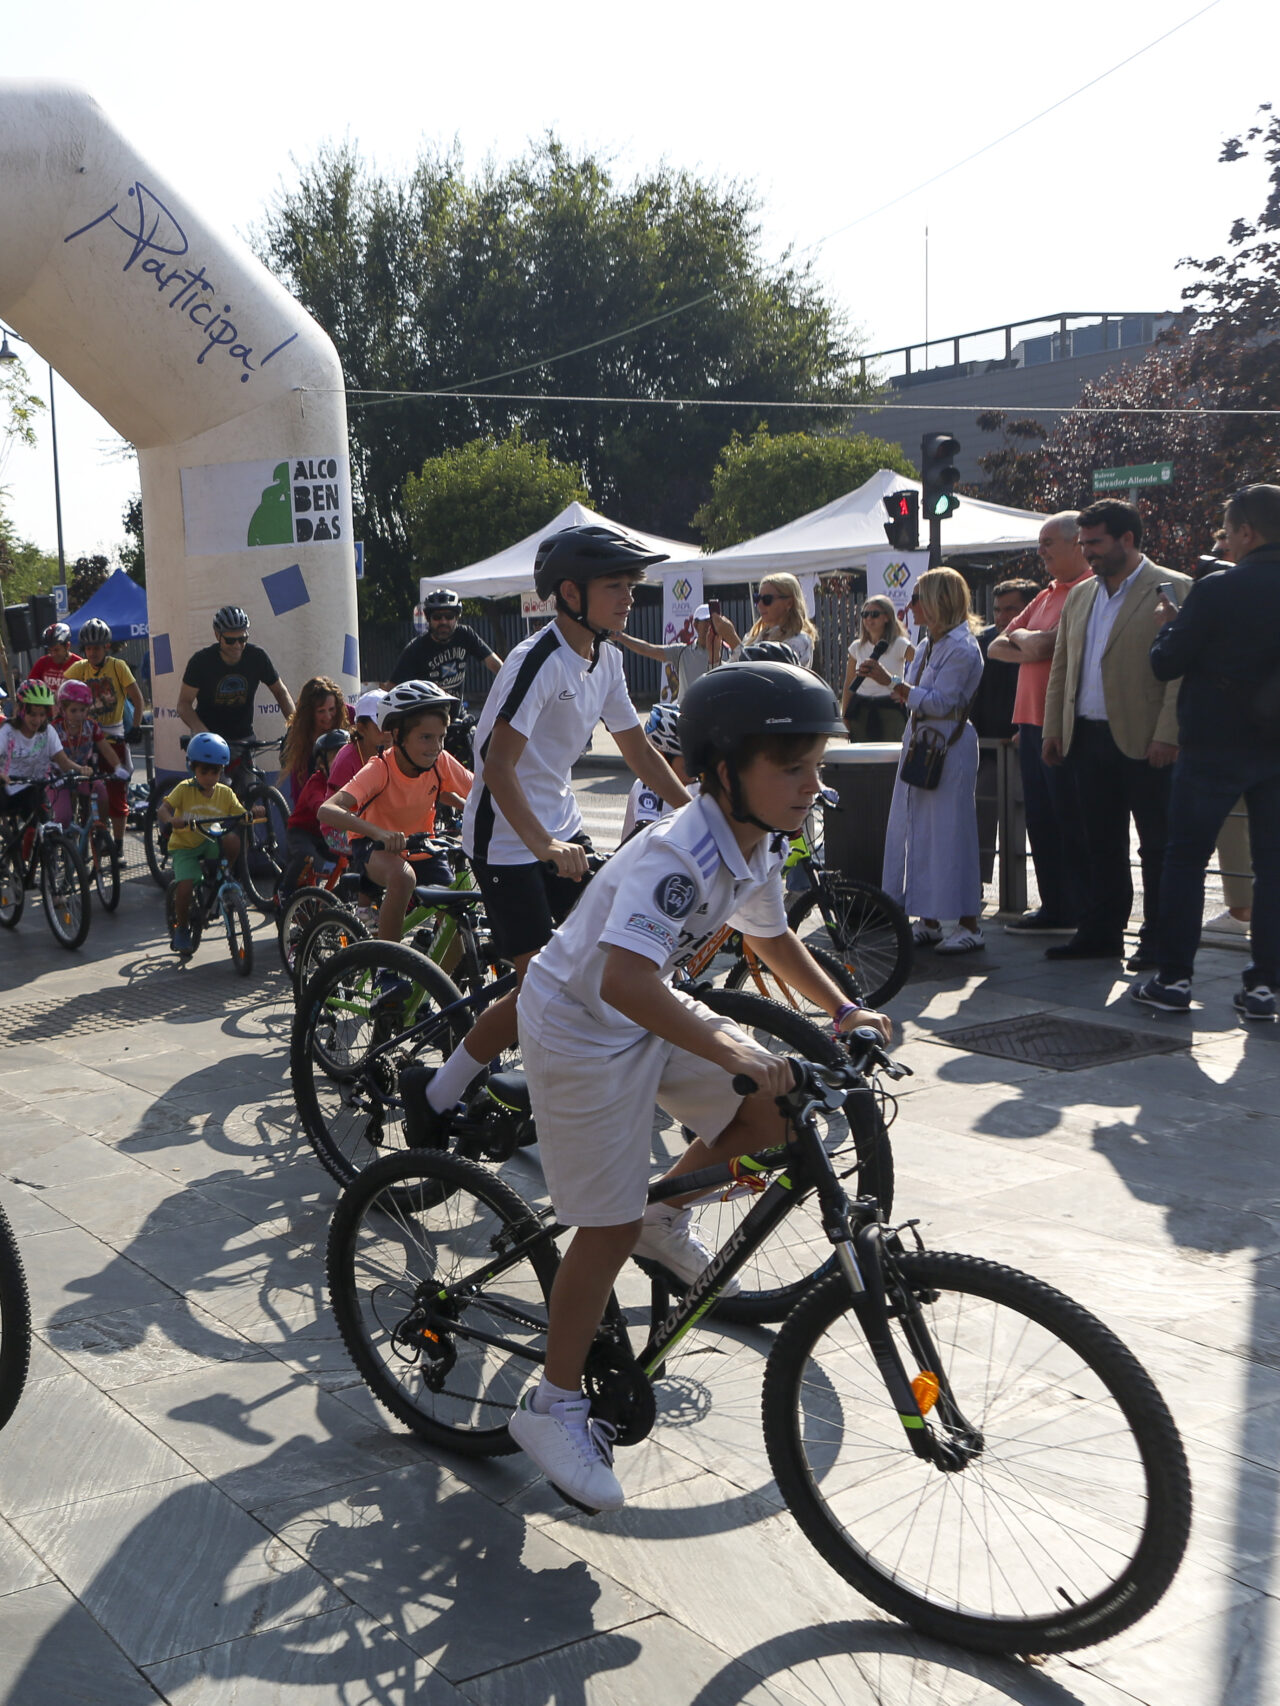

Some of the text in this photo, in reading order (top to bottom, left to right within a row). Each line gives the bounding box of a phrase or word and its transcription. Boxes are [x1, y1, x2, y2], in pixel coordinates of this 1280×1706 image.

[293, 459, 337, 480] ALCO
[1094, 475, 1158, 488] Salvador Allende
[293, 484, 340, 513] BEN
[258, 704, 280, 714] OCAL
[668, 893, 683, 908] 14
[654, 1227, 747, 1347] ROCKRIDER
